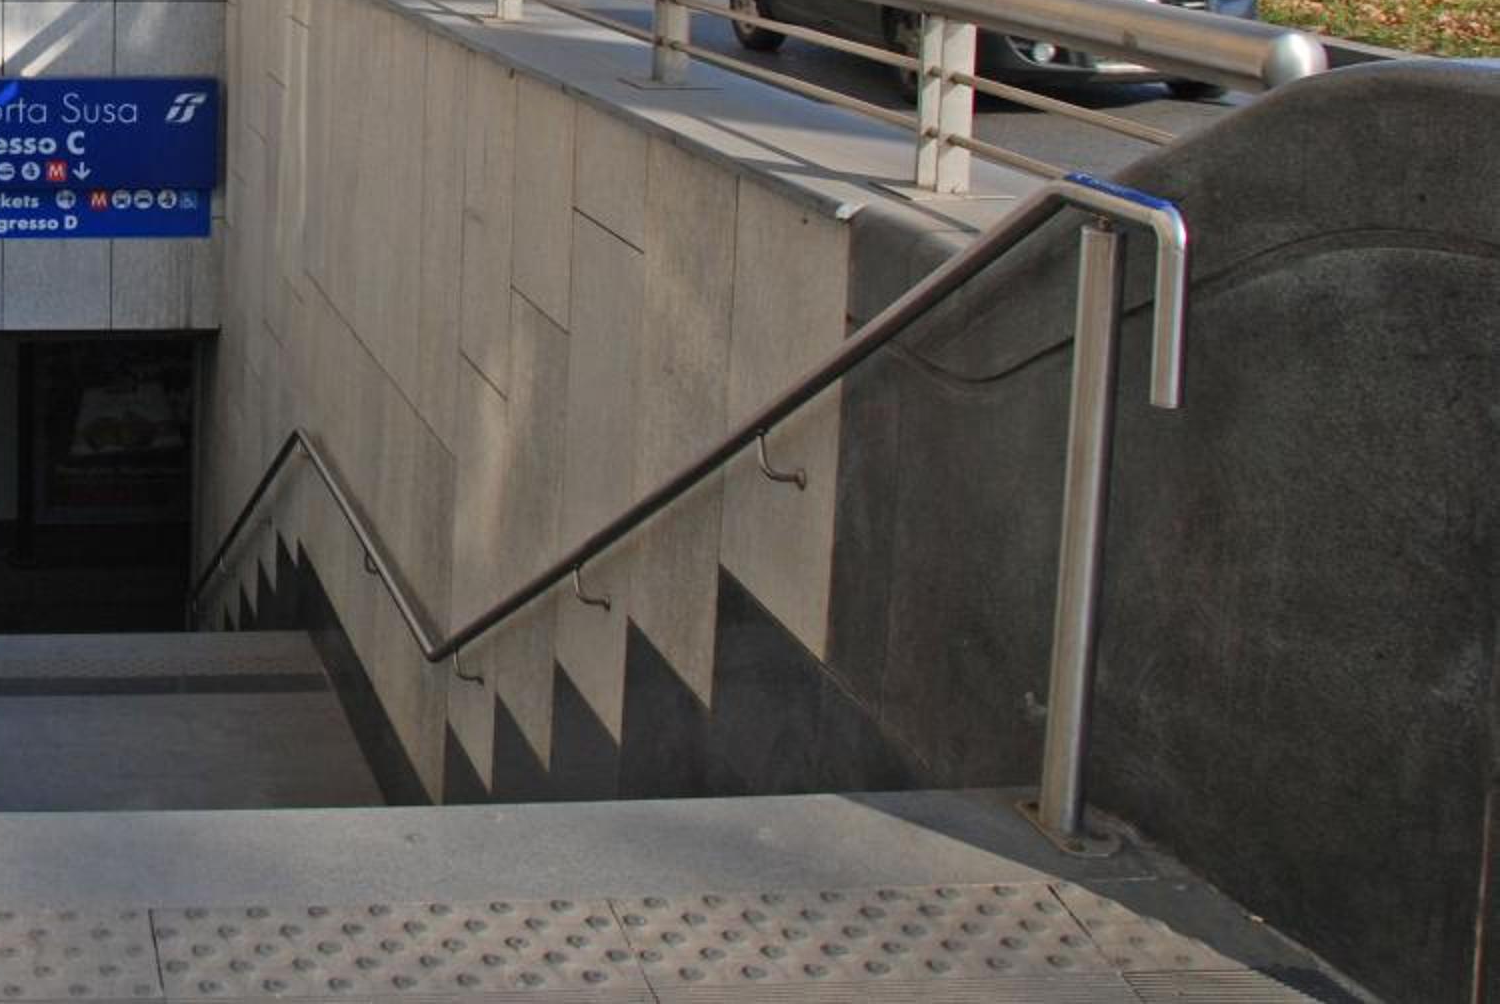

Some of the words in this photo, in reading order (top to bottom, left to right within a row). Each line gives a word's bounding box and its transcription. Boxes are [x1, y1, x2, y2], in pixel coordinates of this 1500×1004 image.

[61, 92, 138, 124] Susa
[66, 130, 85, 156] C
[48, 163, 66, 179] M
[91, 191, 108, 208] M
[63, 215, 78, 230] D
